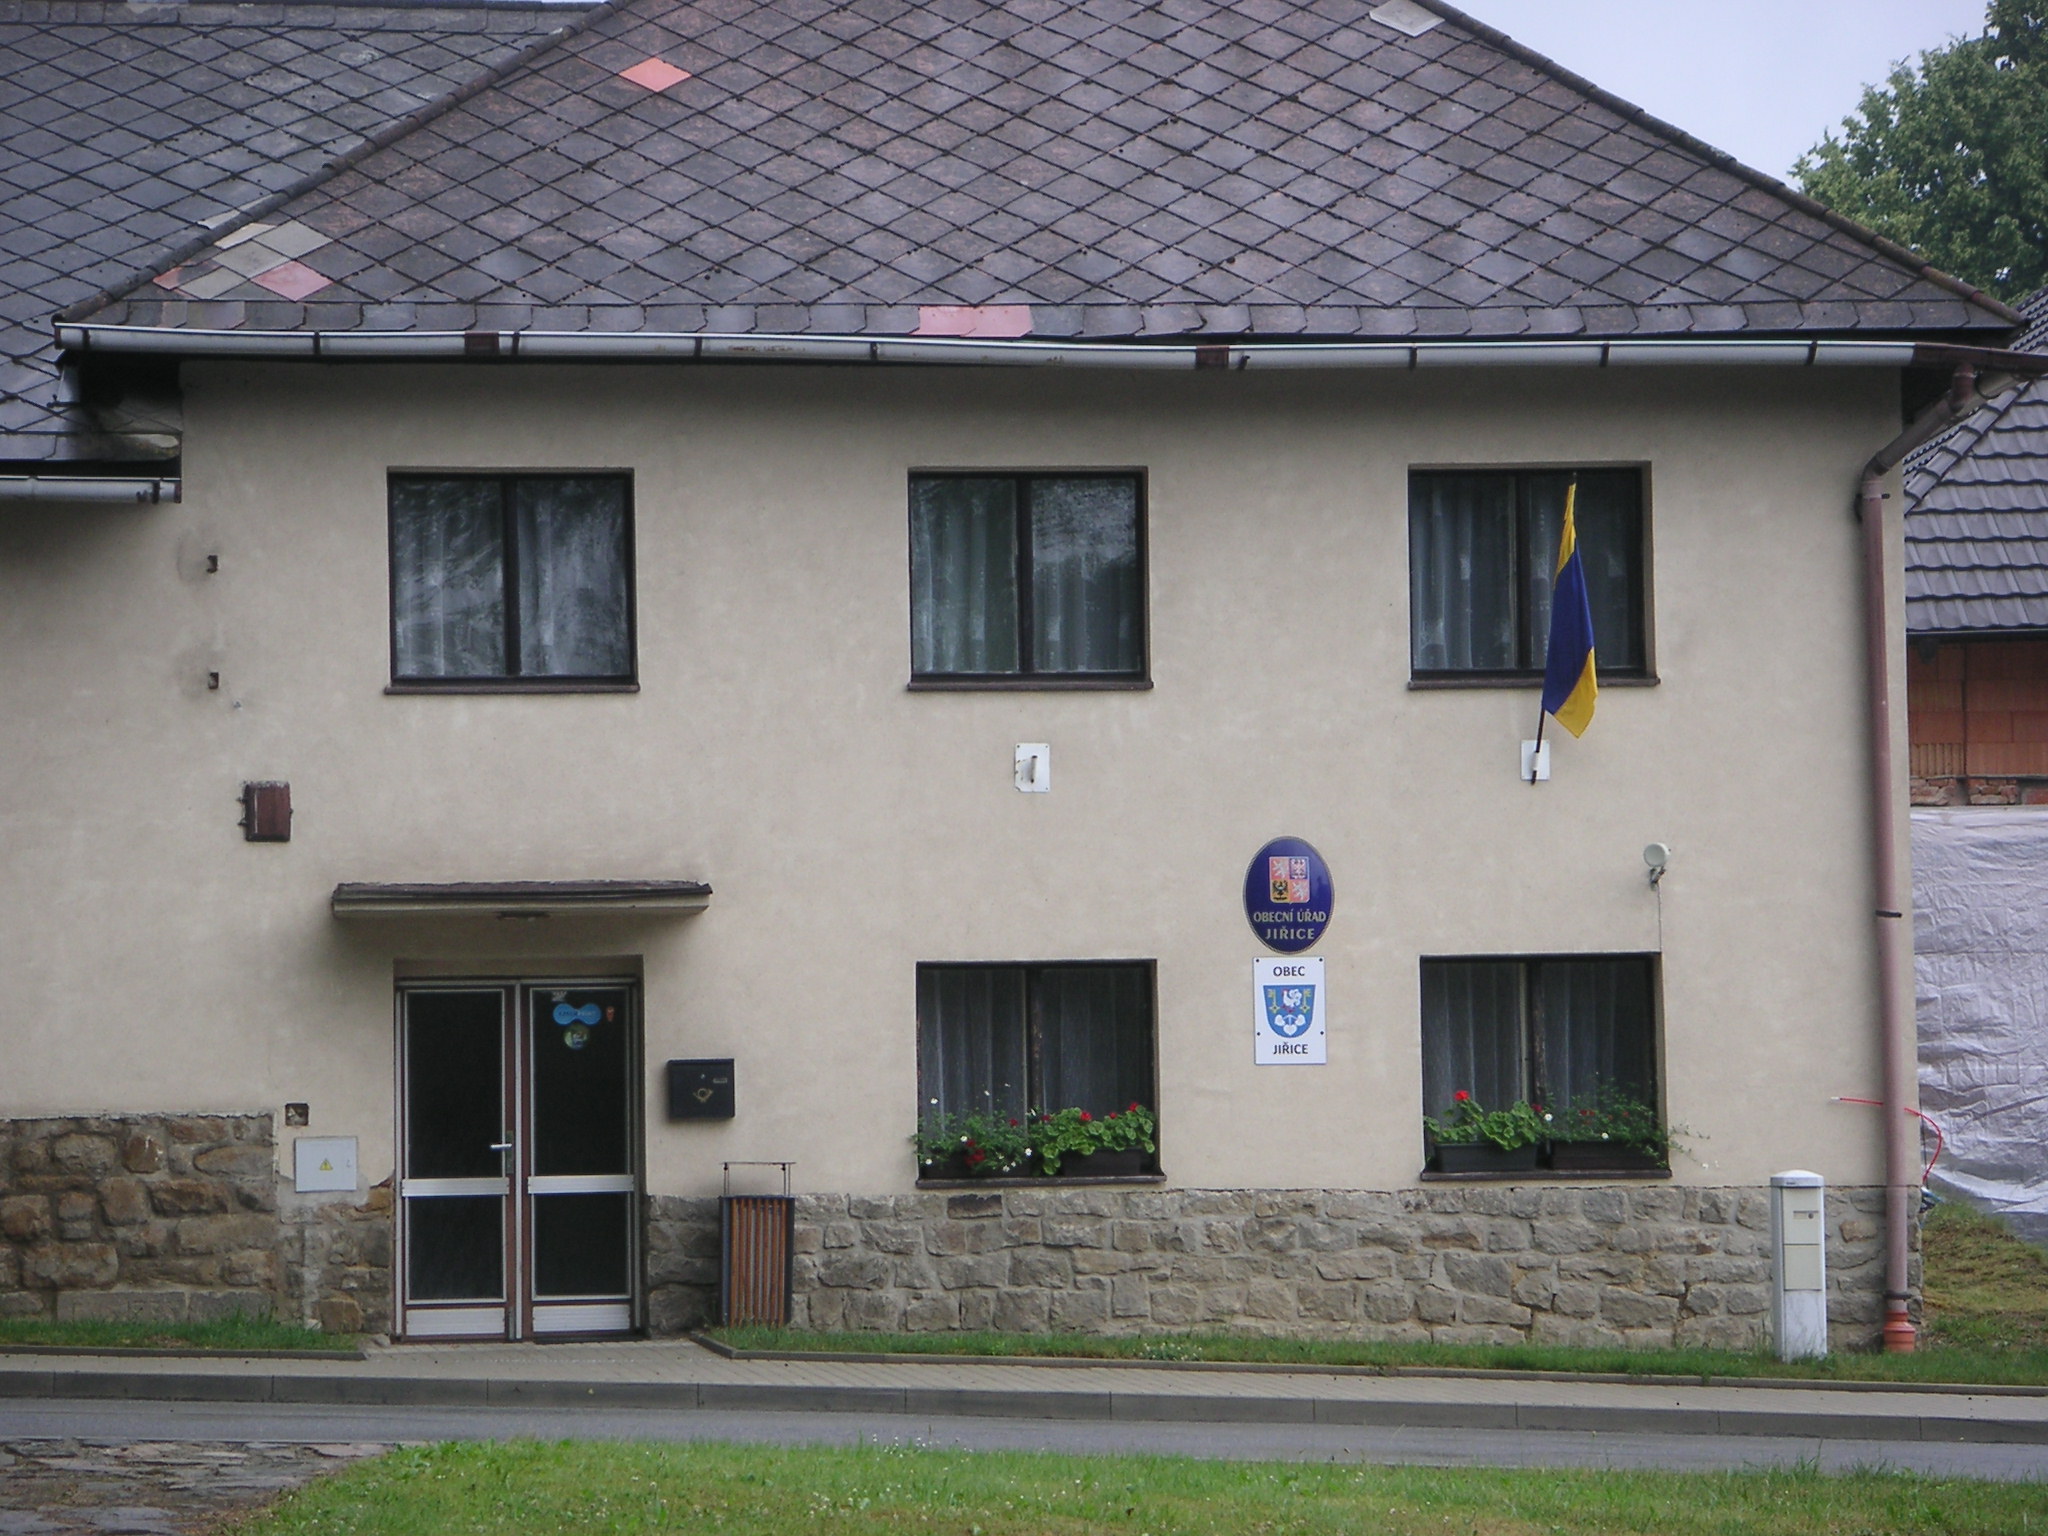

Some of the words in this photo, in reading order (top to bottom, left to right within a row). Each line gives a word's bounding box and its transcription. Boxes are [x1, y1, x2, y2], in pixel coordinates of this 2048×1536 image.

[1253, 908, 1294, 922] OBECNÍ
[1297, 908, 1327, 922] ÚŘAD
[1265, 926, 1315, 940] JIŘICE
[1272, 966, 1306, 977] OBEC
[1273, 1042, 1308, 1055] JIŘICE
